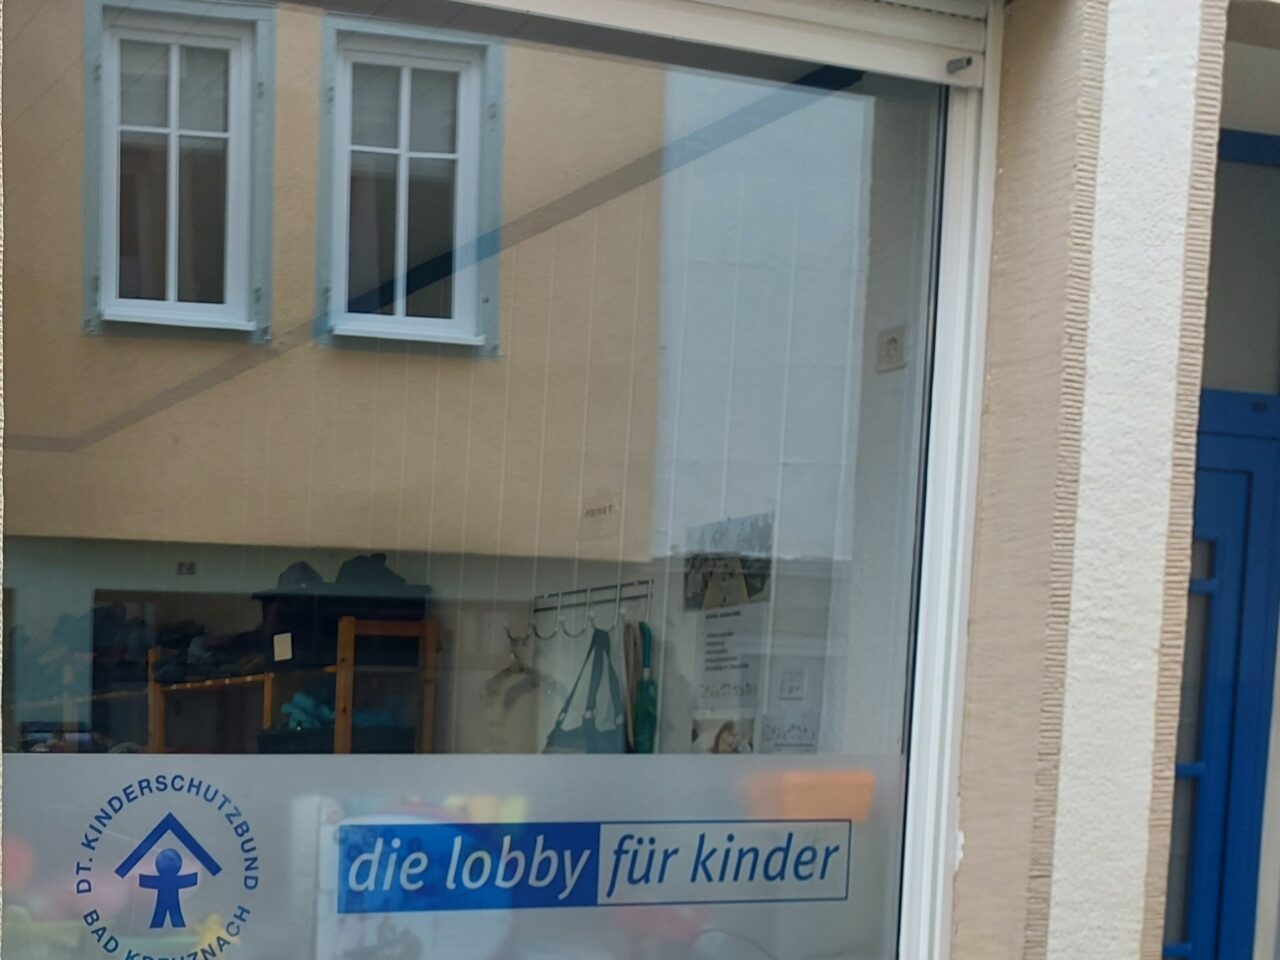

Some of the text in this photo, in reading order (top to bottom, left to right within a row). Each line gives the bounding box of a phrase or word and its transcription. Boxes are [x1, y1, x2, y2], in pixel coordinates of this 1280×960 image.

[76, 775, 259, 894] DT. KINDERSCHUTZBUND
[348, 832, 840, 900] die lobby für kinder
[83, 909, 119, 954] BAD
